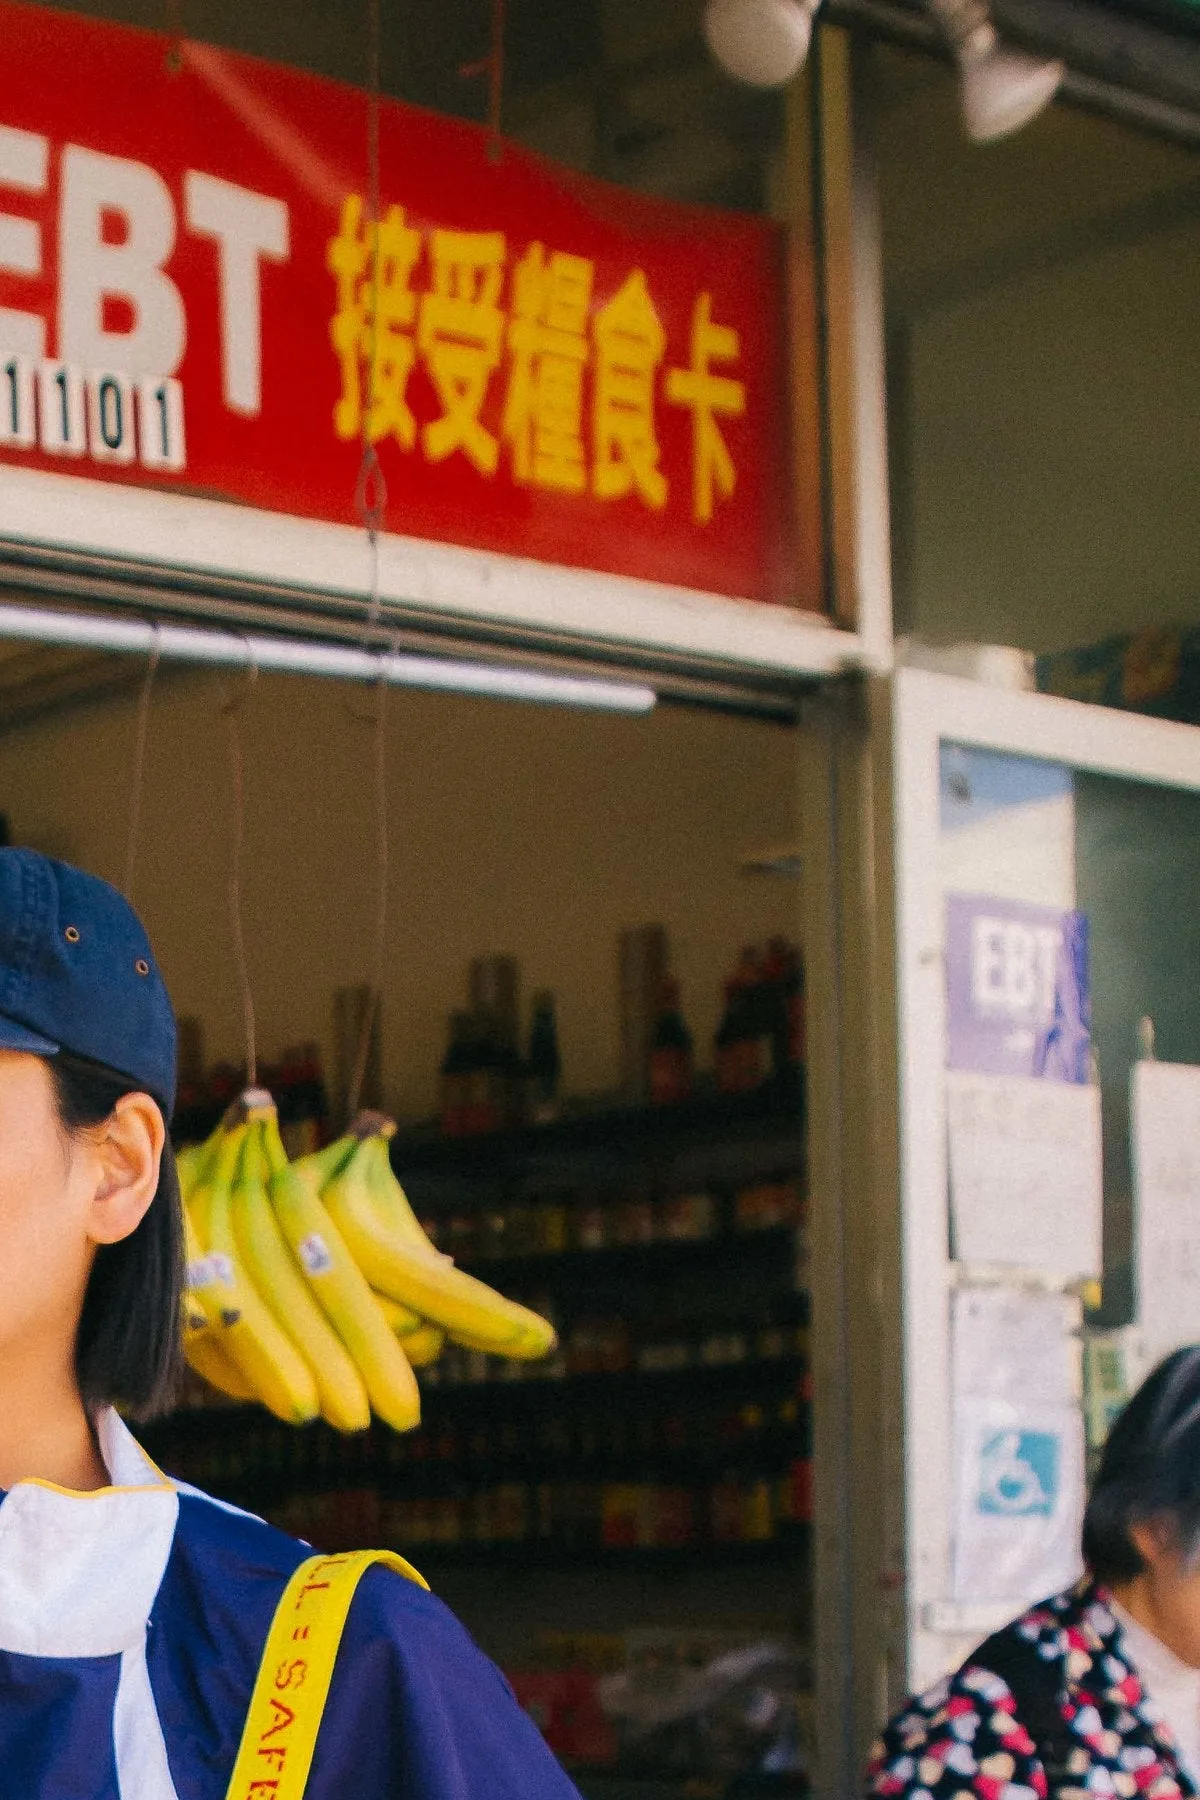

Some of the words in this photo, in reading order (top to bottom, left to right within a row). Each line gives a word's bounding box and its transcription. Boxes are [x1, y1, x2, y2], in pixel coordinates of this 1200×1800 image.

[4, 357, 171, 457] 1101
[326, 193, 746, 527] 接受糧食卡
